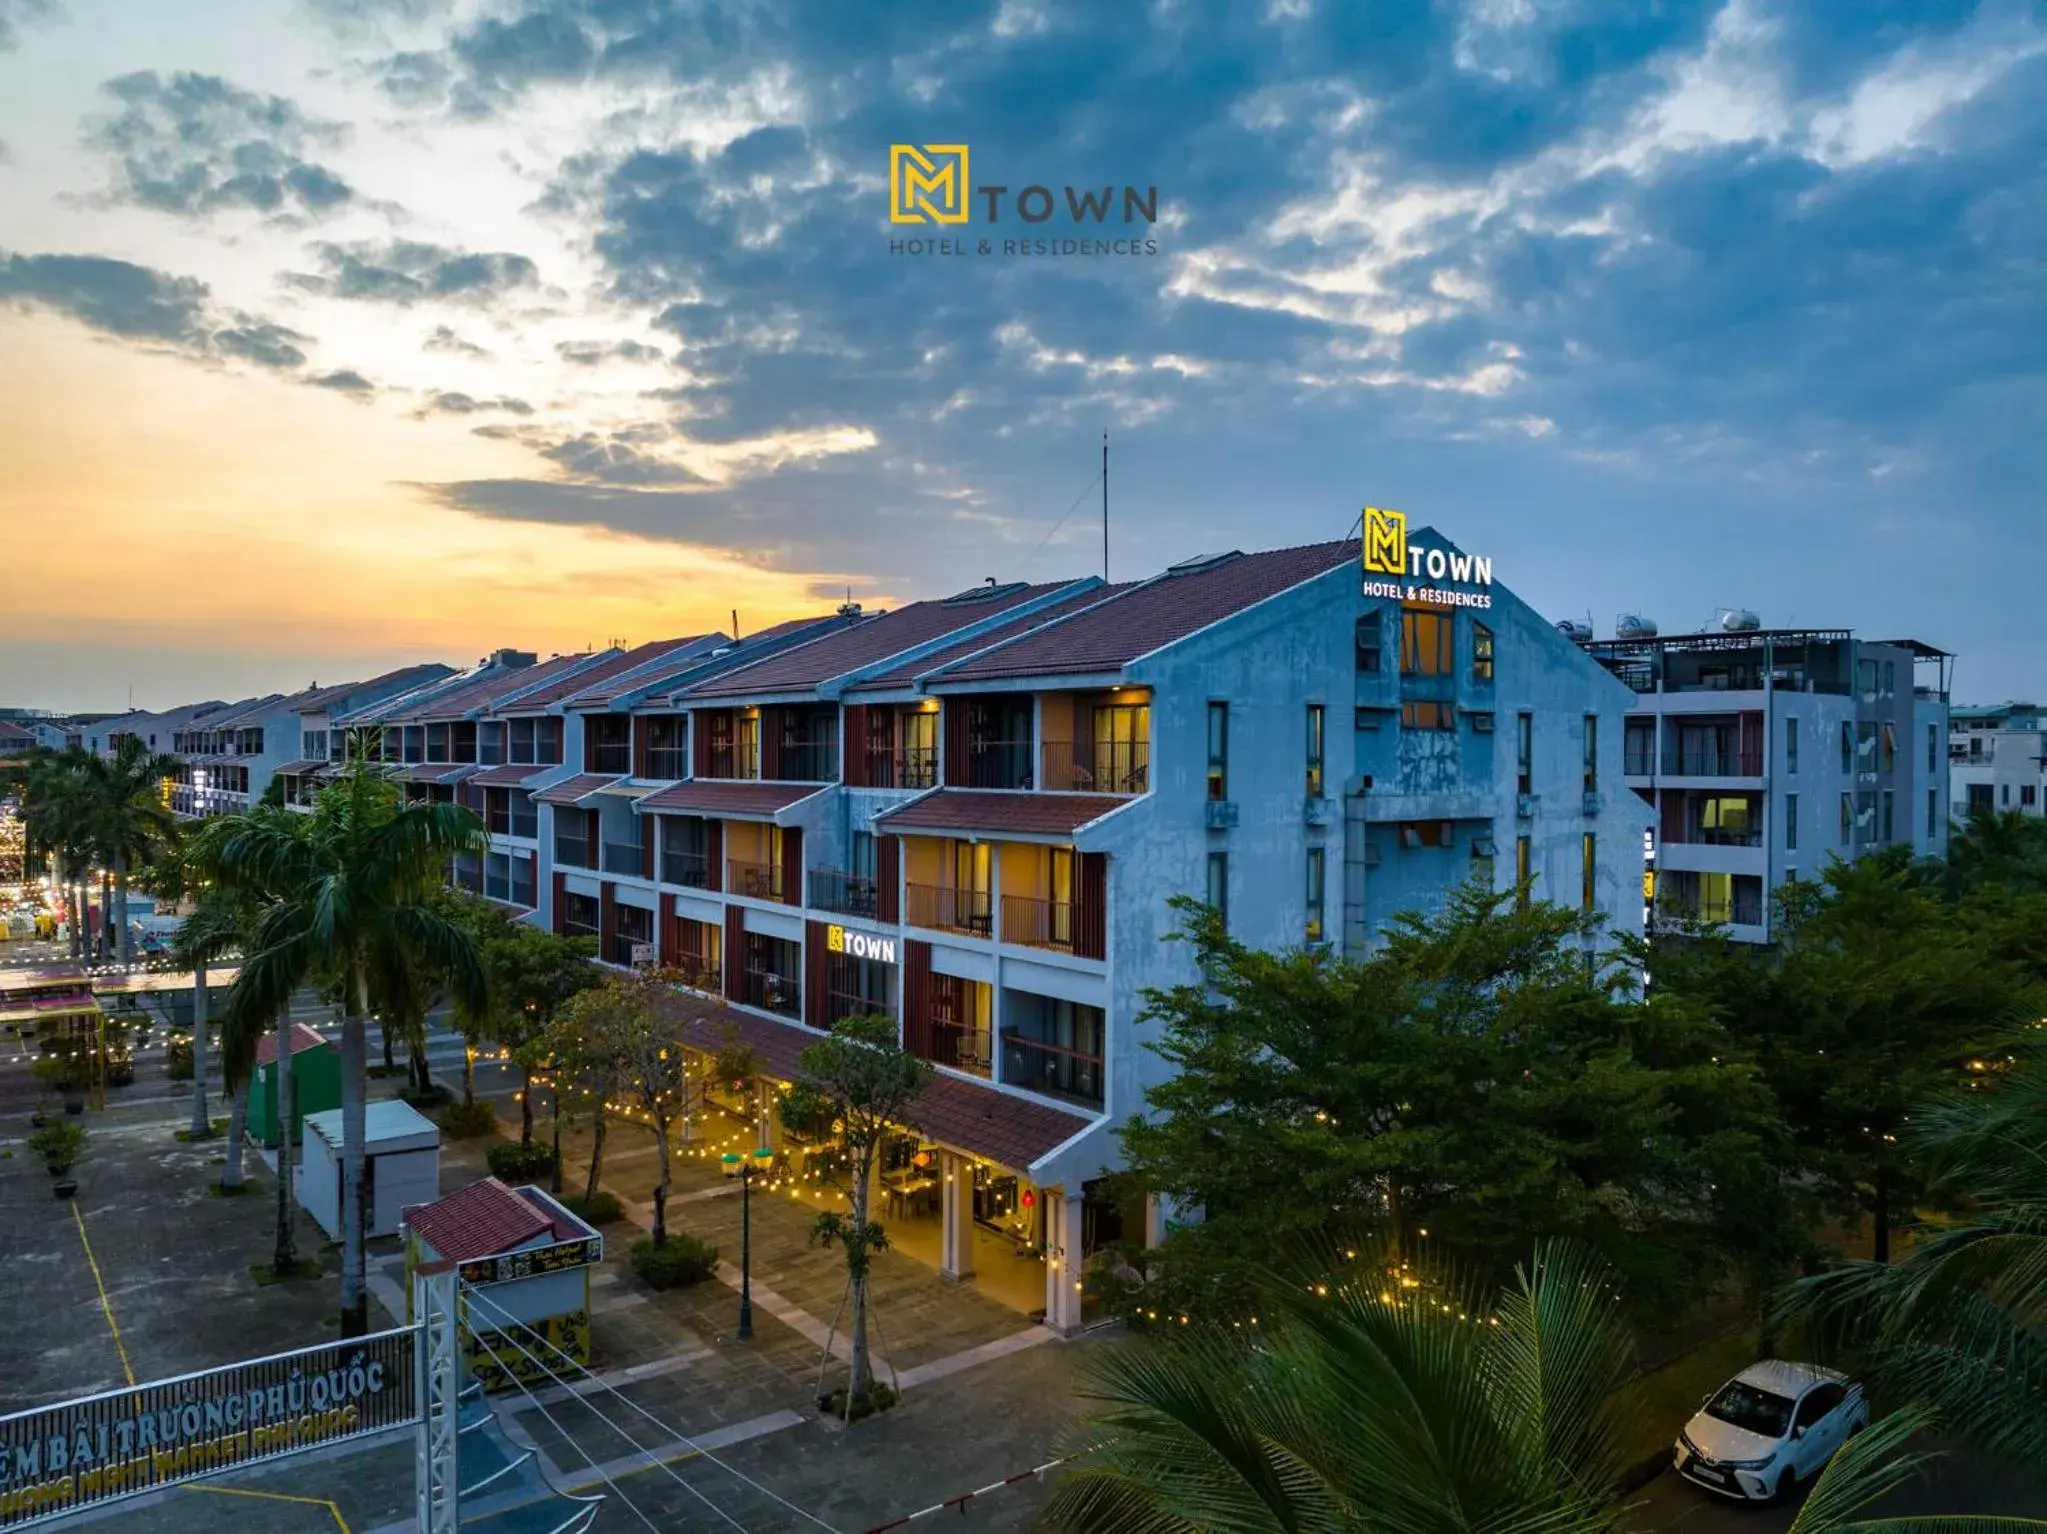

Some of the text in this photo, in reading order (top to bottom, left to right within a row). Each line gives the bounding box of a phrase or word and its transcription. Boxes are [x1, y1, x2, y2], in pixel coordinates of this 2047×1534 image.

[1408, 546, 1492, 585] TOWN
[1363, 581, 1491, 608] HOTEL & RESIDENCES
[844, 932, 895, 963] TOWN
[155, 1430, 250, 1474] MARKET
